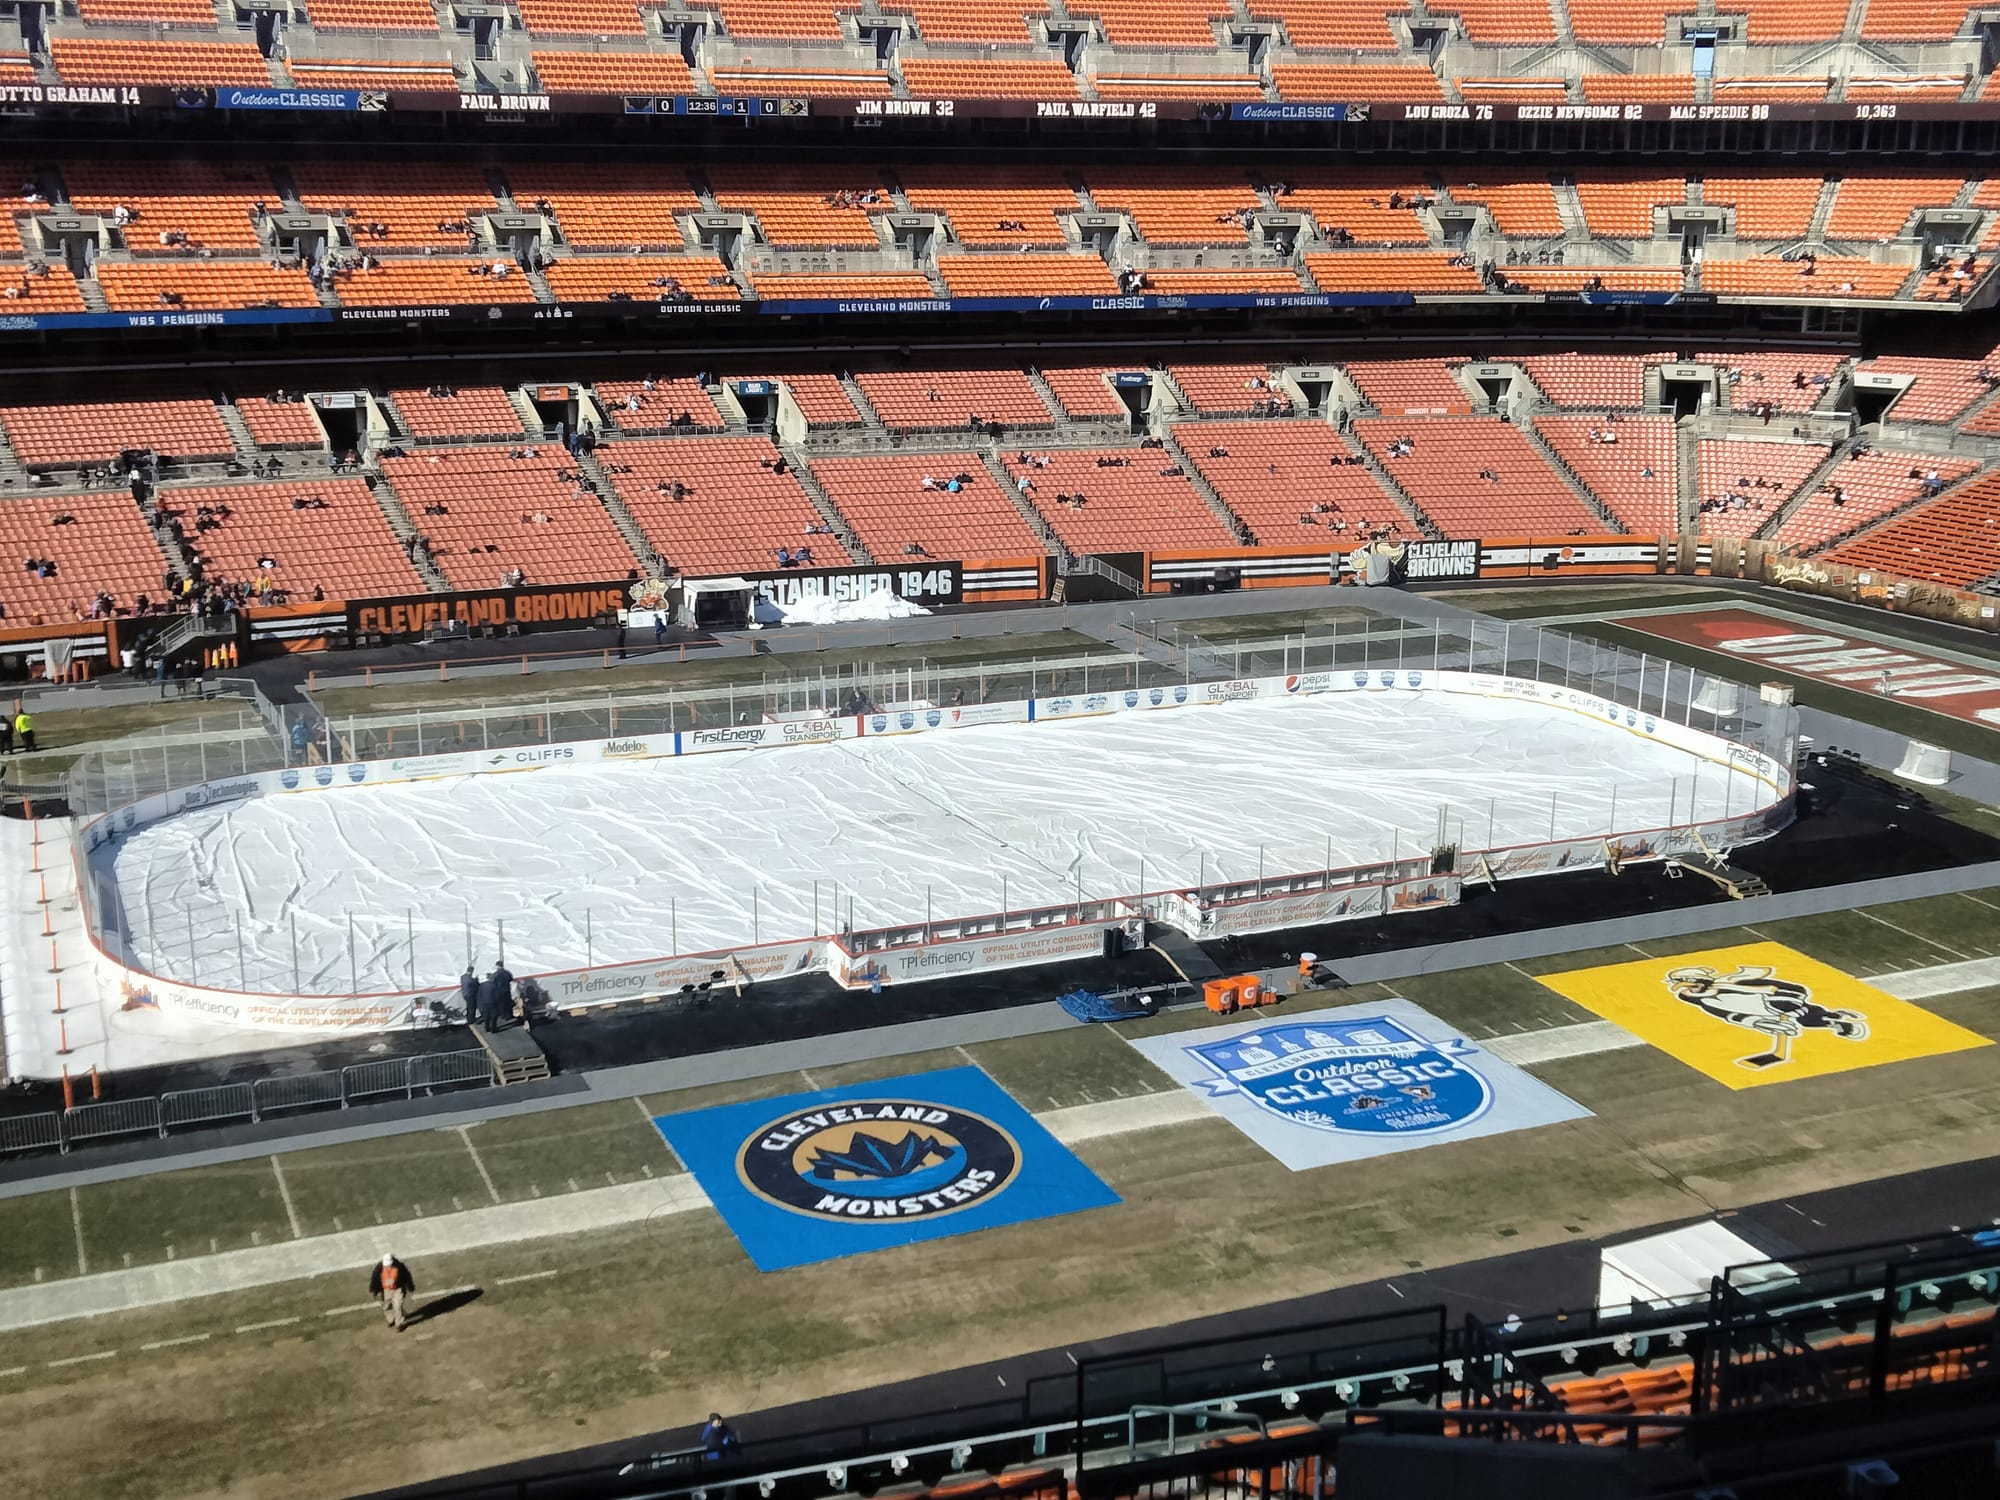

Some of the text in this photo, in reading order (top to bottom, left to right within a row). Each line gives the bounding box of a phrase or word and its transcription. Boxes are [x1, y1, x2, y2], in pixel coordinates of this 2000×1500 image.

[0, 86, 141, 104] OTTO GRAHAM 14
[231, 91, 345, 107] Outdoor CLASSIC
[460, 95, 550, 111] PAUL BROWN
[661, 100, 670, 112] 0
[688, 101, 716, 111] 12:36
[722, 102, 746, 112] PD 1
[765, 101, 774, 113] 0
[856, 100, 954, 116] JIM BROWN 32
[1037, 102, 1157, 118] PAUL WARFIELD 42
[1242, 105, 1335, 118] Outdoor CLASSIC
[1405, 105, 1493, 120] LOU GROZA 76
[1518, 105, 1643, 120] OZZIE NEWSOME 82
[1669, 105, 1770, 119] MAC SPEEDIE 88
[1855, 105, 1896, 120] 10,363
[660, 304, 741, 313] OUTDOOR CLASSIC
[839, 301, 951, 312] CLEVELAND MONSTERS
[1092, 297, 1145, 310] CLASSIC
[1256, 296, 1330, 306] WBS PENGUINS
[129, 313, 224, 326] WBS PENGUINS
[342, 308, 450, 319] CLEVELAND MONSTERS
[1404, 407, 1448, 415] HONOR ROW
[1407, 541, 1476, 559] CLEVELAND
[1407, 556, 1476, 577] BROWNS
[899, 569, 953, 597] 1946
[359, 589, 624, 635] CLEVELAND BROWNS
[1302, 674, 1331, 685] pepsi
[1569, 694, 1604, 712] CLIFFS
[693, 728, 766, 745] FirstEnergy
[783, 730, 842, 743] TRANSPORT
[516, 748, 574, 762] CLIFFS
[607, 741, 642, 754] Modelo
[1219, 902, 1330, 922] OFFICIAL UTILITY CONSULTANT
[1234, 920, 1248, 928] THE
[1251, 915, 1293, 926] CLEVELAND
[982, 931, 1103, 954] OFFICIAL UTILITY CONSULTANT
[999, 953, 1015, 961] THE
[1017, 946, 1064, 959] CLEVELAND
[1065, 941, 1100, 952] BROWNS
[900, 950, 976, 971] TPI efficiency
[655, 966, 695, 979] OFFICIAL
[562, 975, 646, 995] TPI efficiency
[658, 979, 671, 987] OF
[672, 977, 690, 985] THE
[1220, 991, 1231, 1004] G
[1244, 987, 1255, 999] G
[185, 996, 240, 1019] efficiency
[248, 1006, 394, 1016] OFFICIAL UTILITY CONSULTANT
[268, 1016, 285, 1024] THE
[287, 1017, 343, 1026] CLEVELAND
[1244, 1043, 1409, 1078] CLEVELAND MONSTERS
[1294, 1059, 1396, 1082] Outdoor
[1265, 1061, 1459, 1105] CLASSIC
[761, 1105, 949, 1152] CLEVELAND
[815, 1168, 997, 1217] MONSTERS
